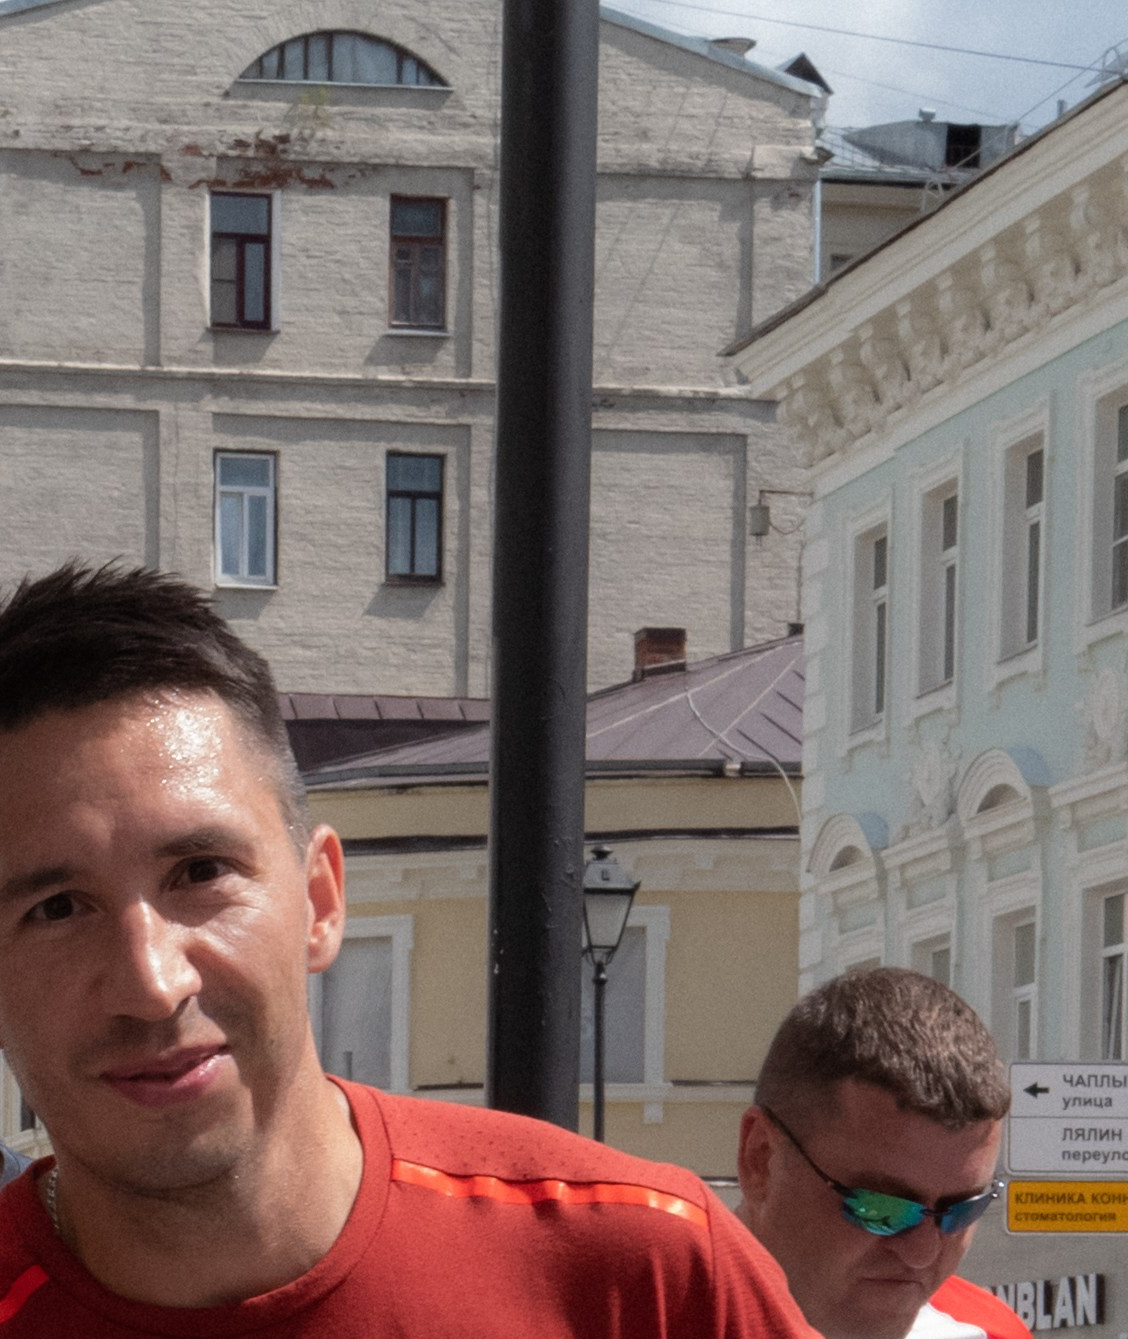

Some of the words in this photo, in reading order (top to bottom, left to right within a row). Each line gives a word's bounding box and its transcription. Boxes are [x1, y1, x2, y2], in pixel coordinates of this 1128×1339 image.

[1062, 1096, 1113, 1111] улица
[1062, 1127, 1122, 1142] ЛЯЛИН
[1014, 1192, 1087, 1205] КЛИНИКА
[1014, 1212, 1117, 1222] стоматология
